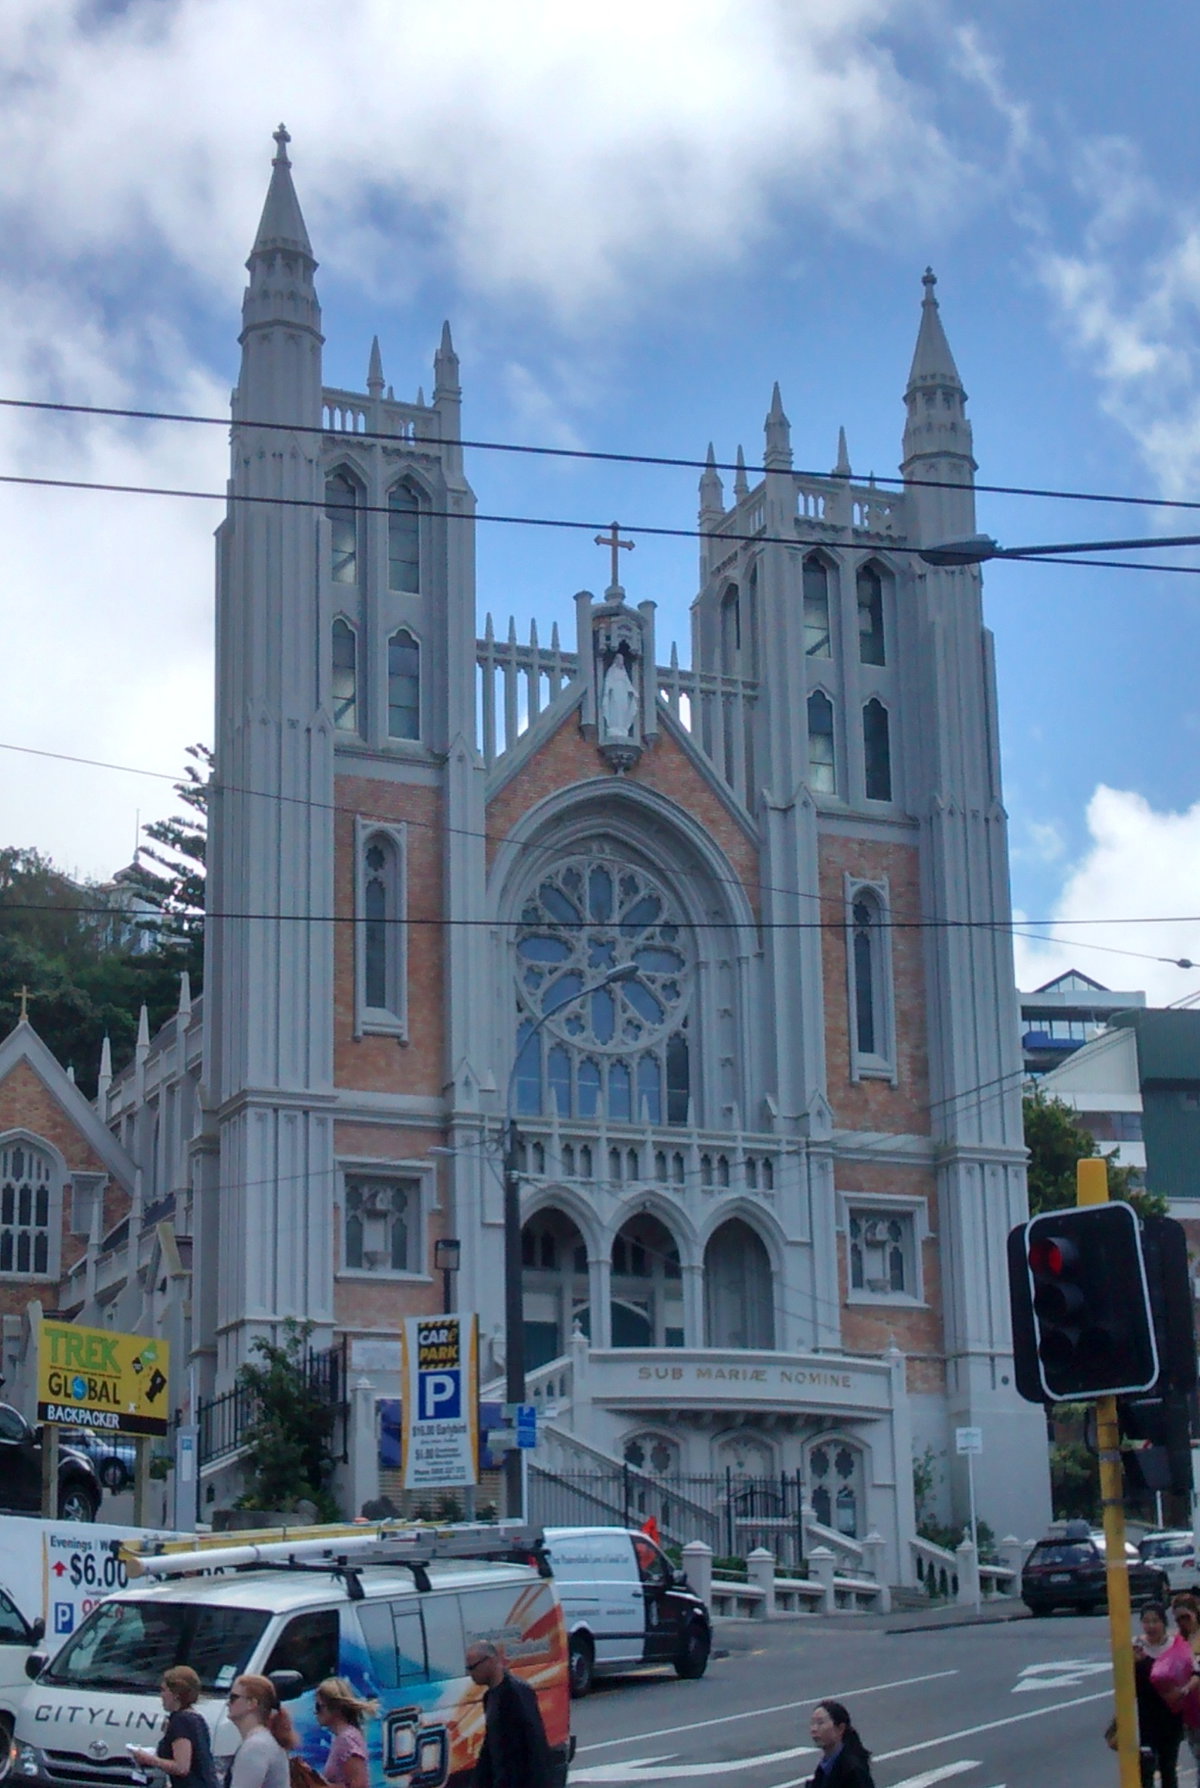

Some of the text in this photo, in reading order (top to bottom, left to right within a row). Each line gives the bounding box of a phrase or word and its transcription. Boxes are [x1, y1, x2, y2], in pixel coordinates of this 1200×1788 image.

[44, 1327, 122, 1373] TREK
[420, 1345, 458, 1360] PARK
[638, 1366, 684, 1380] SUB
[48, 1372, 121, 1404] GLOBAL
[425, 1374, 455, 1417] P
[47, 1404, 120, 1429] BACKPACKER
[50, 1535, 92, 1550] Evenings
[70, 1553, 129, 1589] $6.00
[58, 1604, 71, 1631] P
